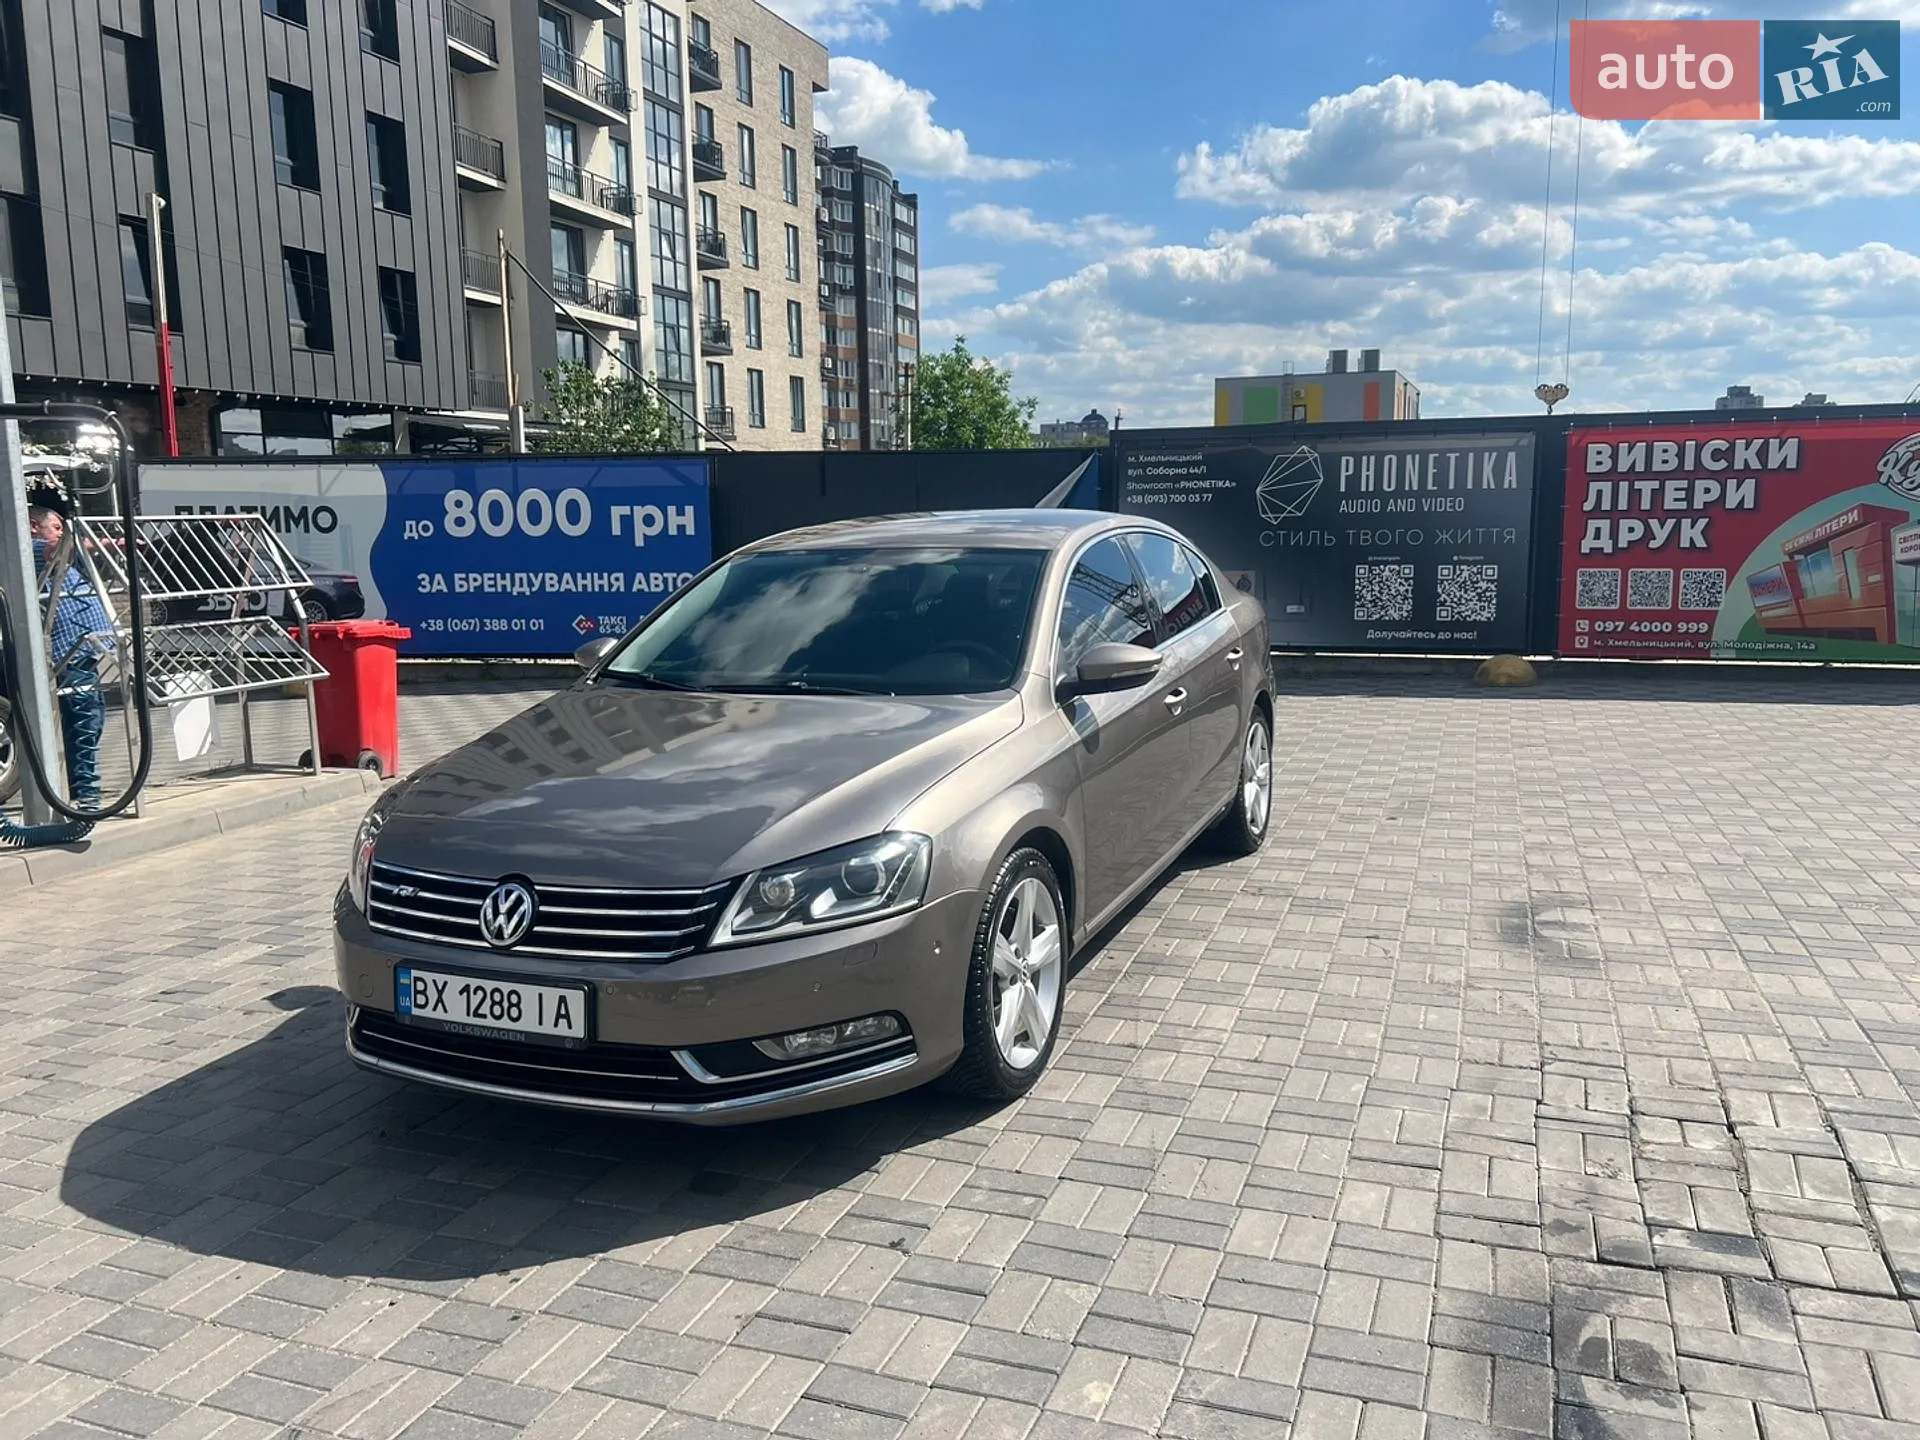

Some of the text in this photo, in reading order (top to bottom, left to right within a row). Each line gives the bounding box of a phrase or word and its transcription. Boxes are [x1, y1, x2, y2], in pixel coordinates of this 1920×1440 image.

[1585, 437, 1800, 473] ВИВІСКИ
[1146, 466, 1187, 476] Соборна
[1339, 452, 1518, 493] PHONETIKA
[1127, 481, 1173, 490] Showroom
[1127, 493, 1213, 504] +38 (093) 700 03 77
[1582, 478, 1756, 512] ЛІТЕРИ
[1339, 497, 1465, 513] AUDIO AND VIDEO
[404, 488, 695, 547] до 8000 грн
[1259, 528, 1516, 547] СТИЛЬ ТВОГО ЖИТТЯ
[1580, 518, 1709, 553] ДРУК
[417, 573, 448, 593] ЗА
[454, 572, 625, 595] БРЕНДУВАННЯ
[420, 618, 545, 632] +38 (067) 388 01 01
[1594, 621, 1709, 633] 097 4000 999
[1366, 629, 1478, 640] Долучайтесь до нас!
[1607, 638, 1694, 649] Хмельницький,
[1697, 641, 1719, 650] вул.
[1724, 641, 1794, 651] Молодіжна,
[400, 996, 411, 1007] UA
[458, 983, 523, 1023] 1288
[443, 1022, 526, 1042] VOLKSWAGEN
